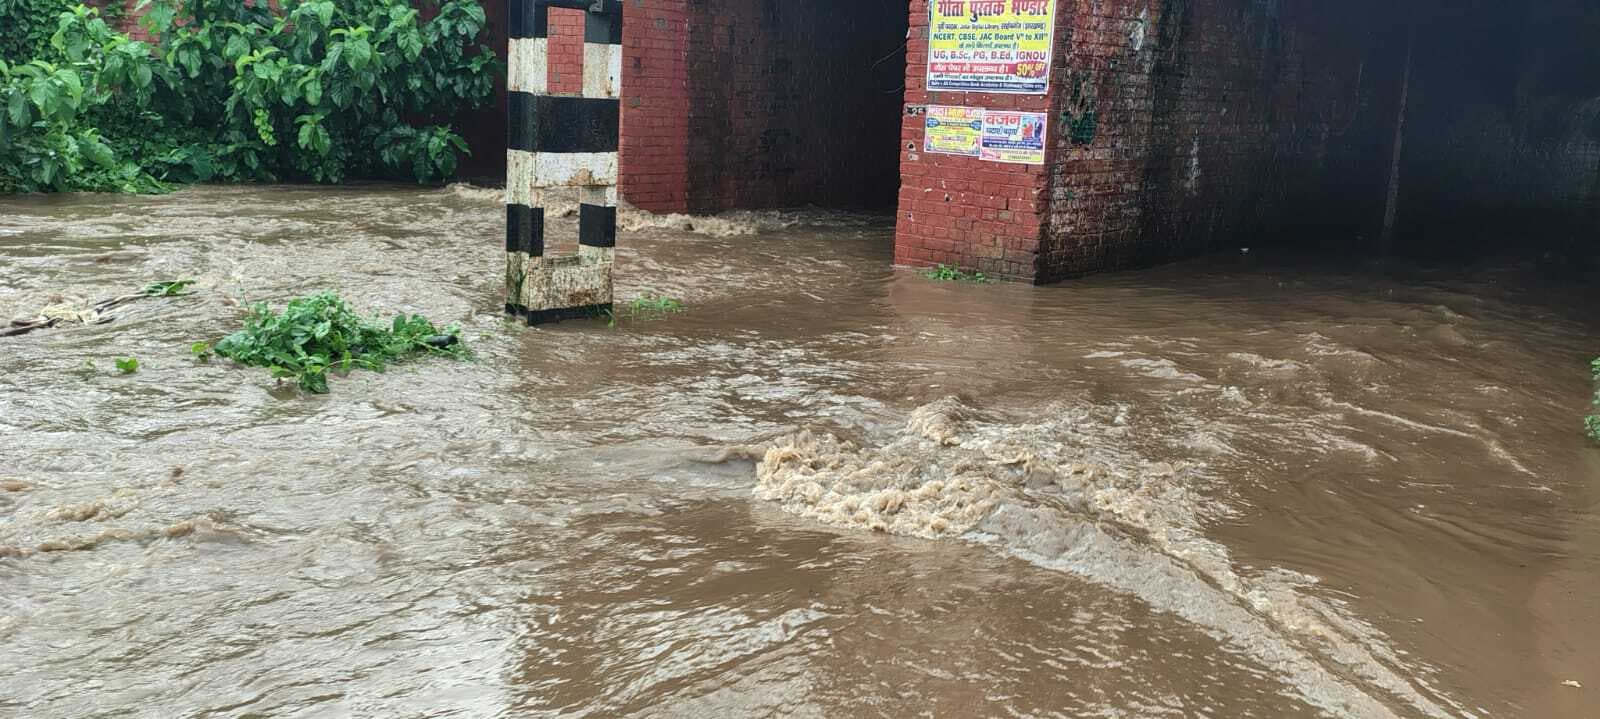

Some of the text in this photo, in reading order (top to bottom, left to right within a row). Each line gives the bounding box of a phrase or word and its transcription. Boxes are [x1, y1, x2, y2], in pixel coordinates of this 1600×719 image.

[979, 33, 993, 41] JAC
[995, 32, 1014, 41] Board
[1025, 33, 1033, 41] to
[933, 51, 1046, 60] UG, B.Sc, PG, B.Ed, IGNOU
[1016, 63, 1035, 76] 50%
[985, 115, 1021, 125] वजन
